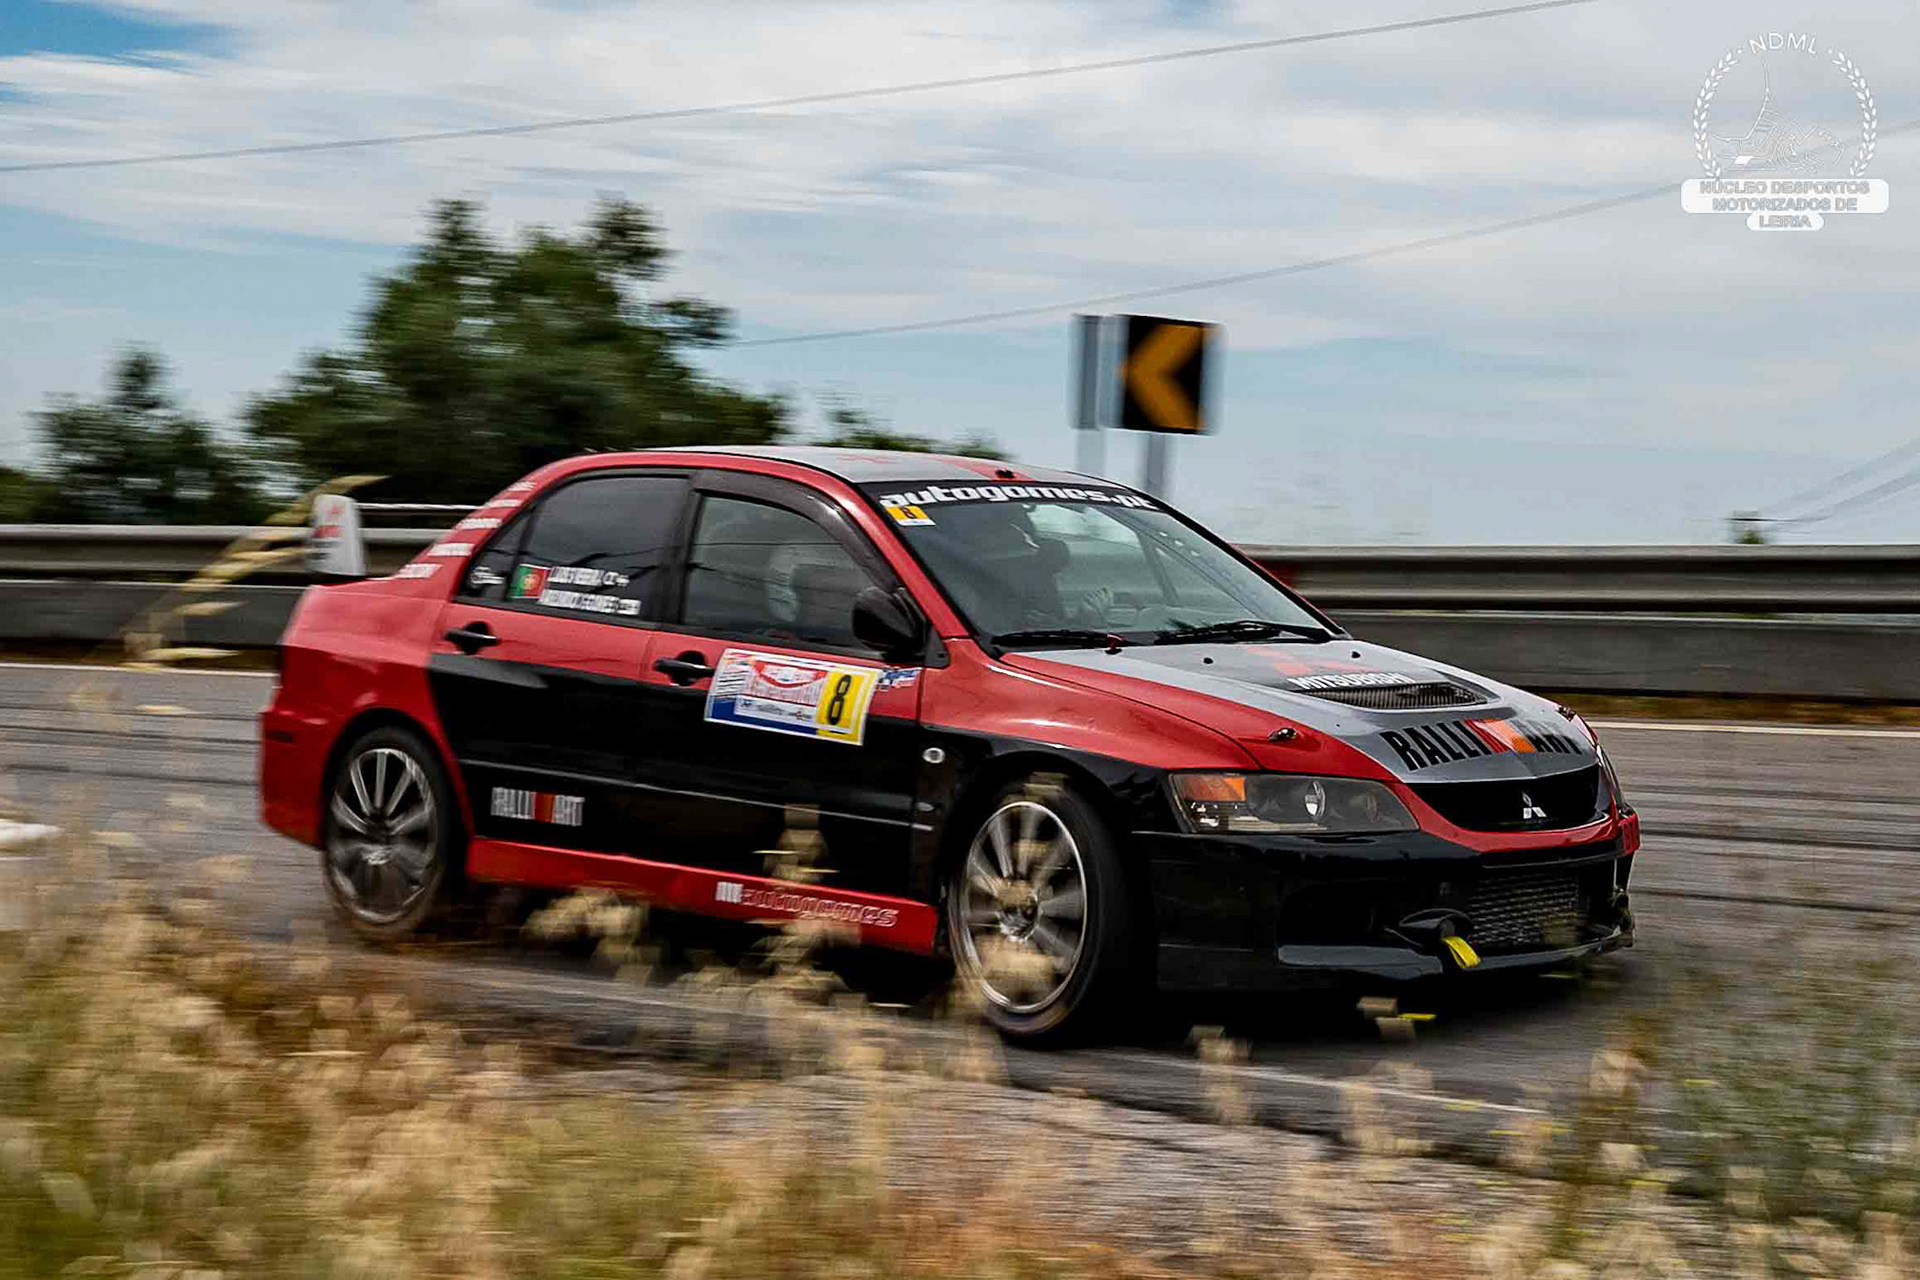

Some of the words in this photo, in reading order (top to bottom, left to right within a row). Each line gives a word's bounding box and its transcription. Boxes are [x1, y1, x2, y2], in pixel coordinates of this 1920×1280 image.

[901, 506, 916, 519] 8
[827, 674, 852, 726] 8
[1379, 720, 1492, 772] RALLI
